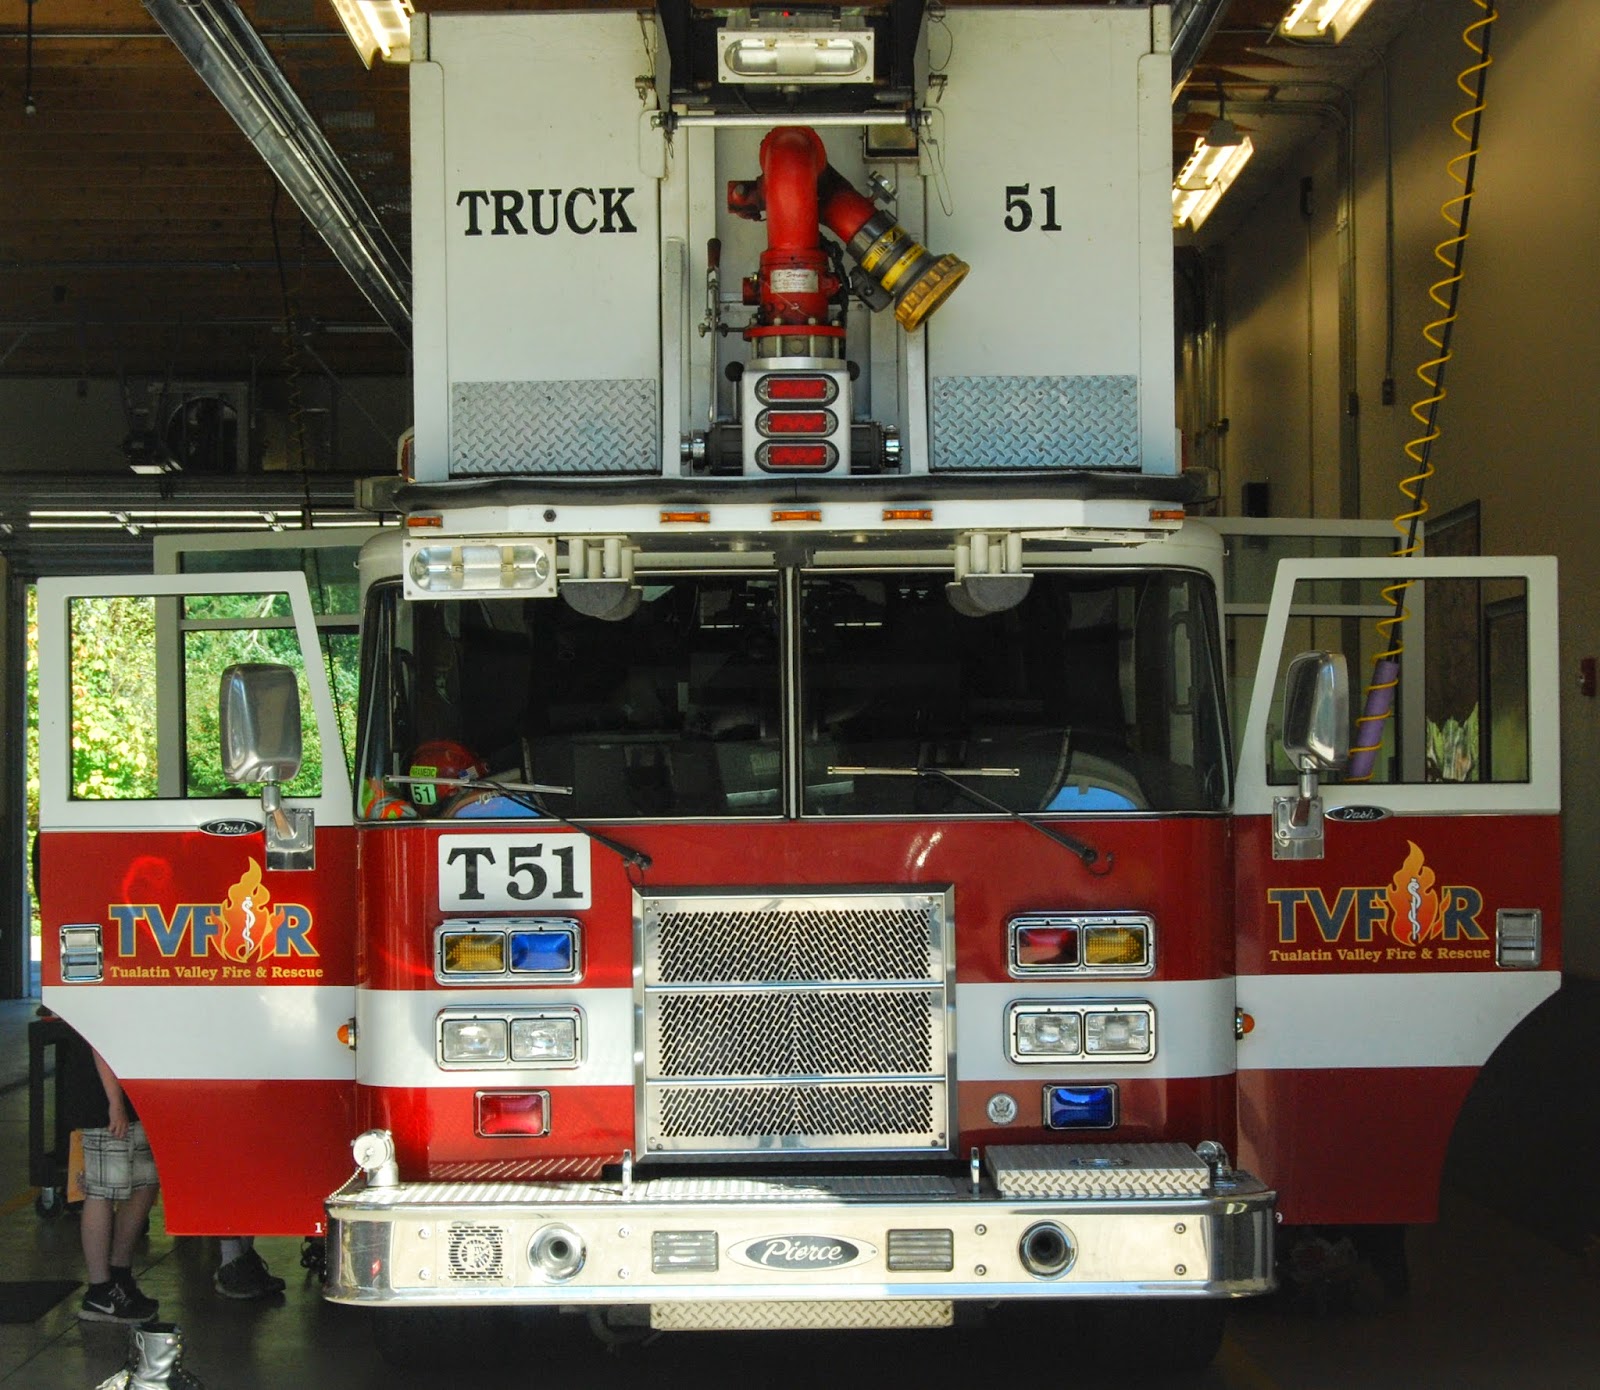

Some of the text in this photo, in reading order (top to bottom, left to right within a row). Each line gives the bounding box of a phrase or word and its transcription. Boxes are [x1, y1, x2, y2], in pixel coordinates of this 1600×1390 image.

[456, 187, 637, 236] TRUCK
[1004, 183, 1062, 232] 51
[413, 784, 431, 804] 51
[1343, 808, 1375, 820] Dash
[216, 822, 248, 834] Dash
[1269, 948, 1490, 963] Tualatin Valley Fire & Rescue
[110, 966, 324, 981] Tualatin Valley Fire & Rescue
[760, 1239, 843, 1265] Pierce
